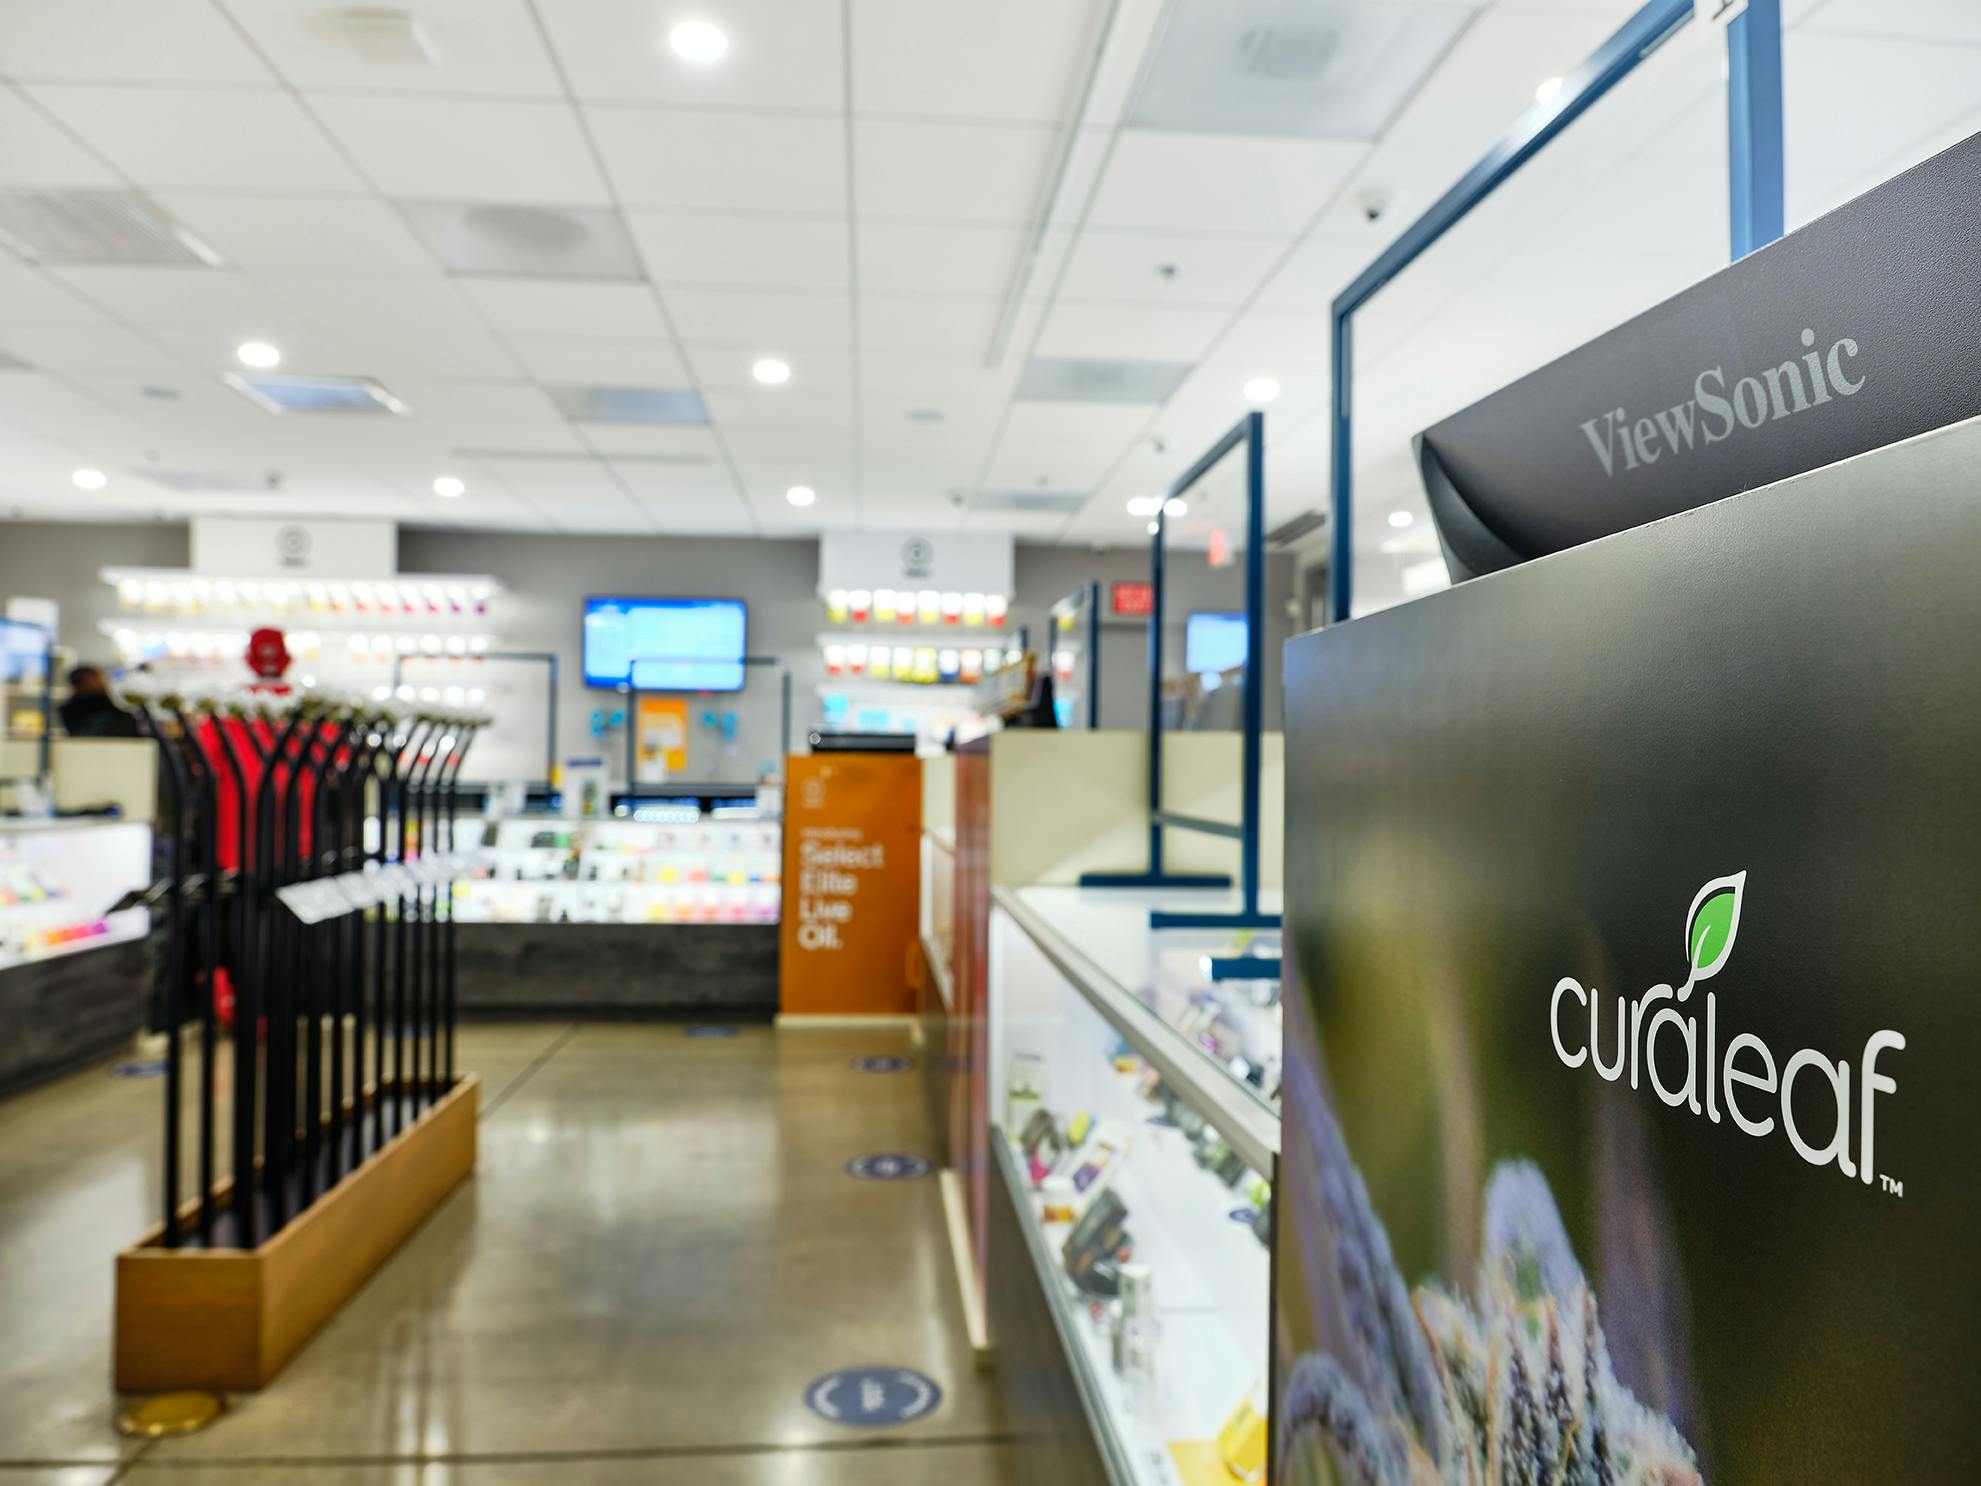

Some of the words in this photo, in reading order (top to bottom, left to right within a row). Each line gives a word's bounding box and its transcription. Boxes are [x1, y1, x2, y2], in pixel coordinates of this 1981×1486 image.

[1580, 328, 1865, 477] ViewSonic
[801, 843, 885, 868] Select
[801, 871, 858, 895] Elite
[800, 899, 852, 921] Live
[1551, 977, 1906, 1184] curaleaf
